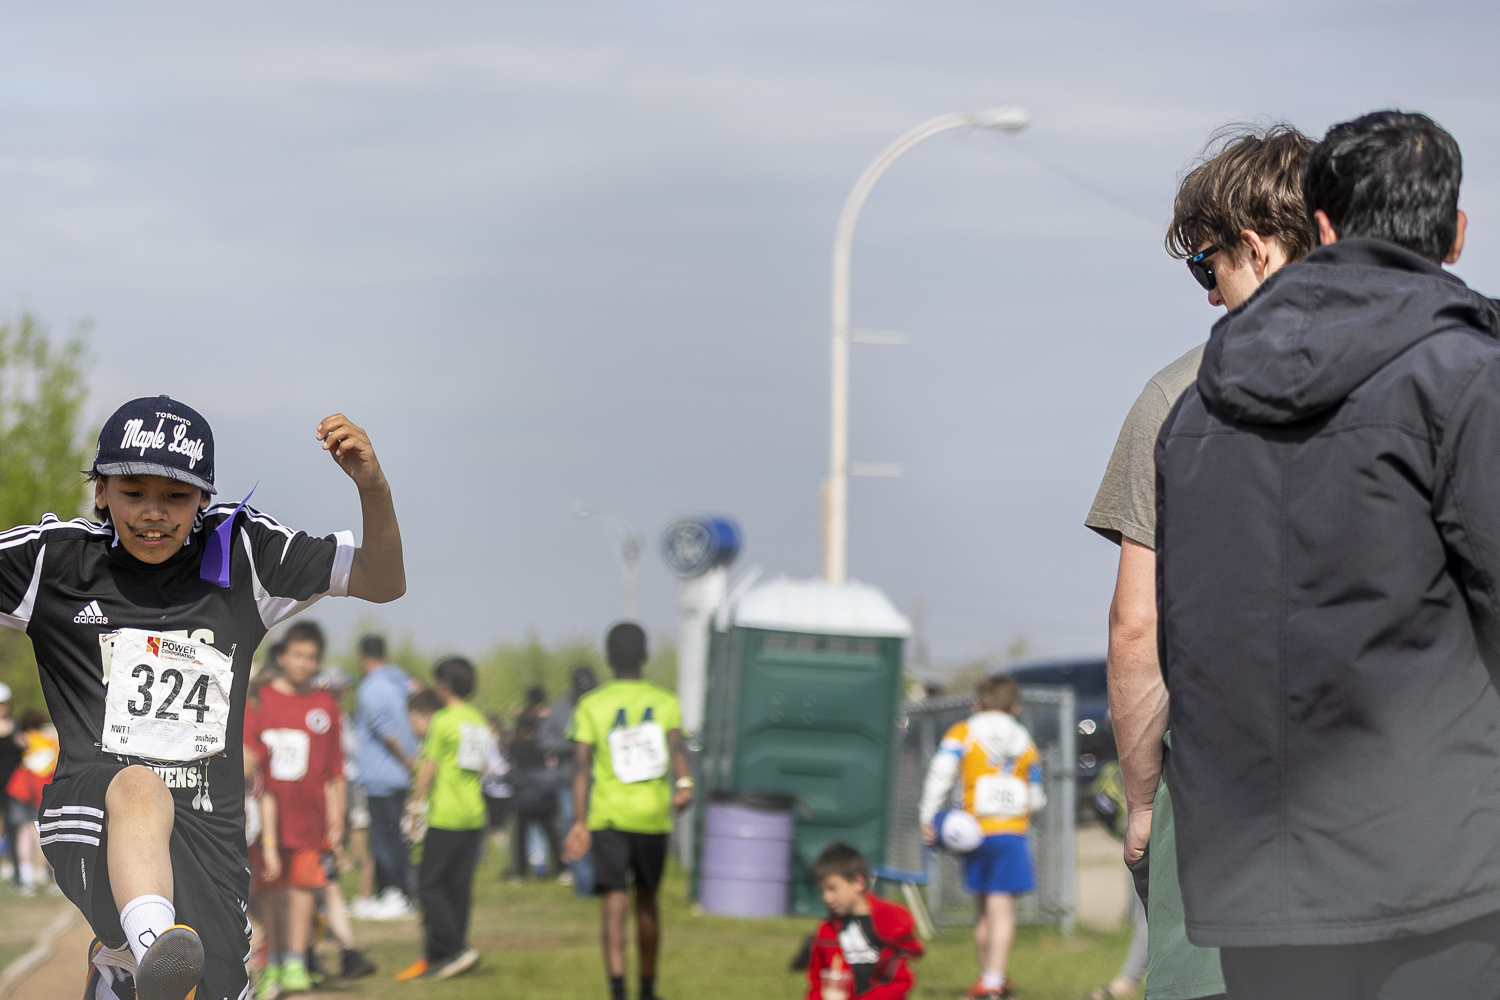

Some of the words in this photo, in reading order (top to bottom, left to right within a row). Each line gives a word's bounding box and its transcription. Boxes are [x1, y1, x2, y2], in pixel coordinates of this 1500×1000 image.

[155, 411, 192, 426] TORONTO
[120, 418, 166, 457] Maple
[167, 423, 205, 470] Leafs
[73, 614, 109, 625] adidas
[160, 648, 196, 660] CORPORATION
[161, 641, 196, 655] POWER
[127, 663, 210, 723] 324
[110, 724, 126, 734] NWT
[194, 744, 208, 753] 026
[147, 766, 197, 789] VENS
